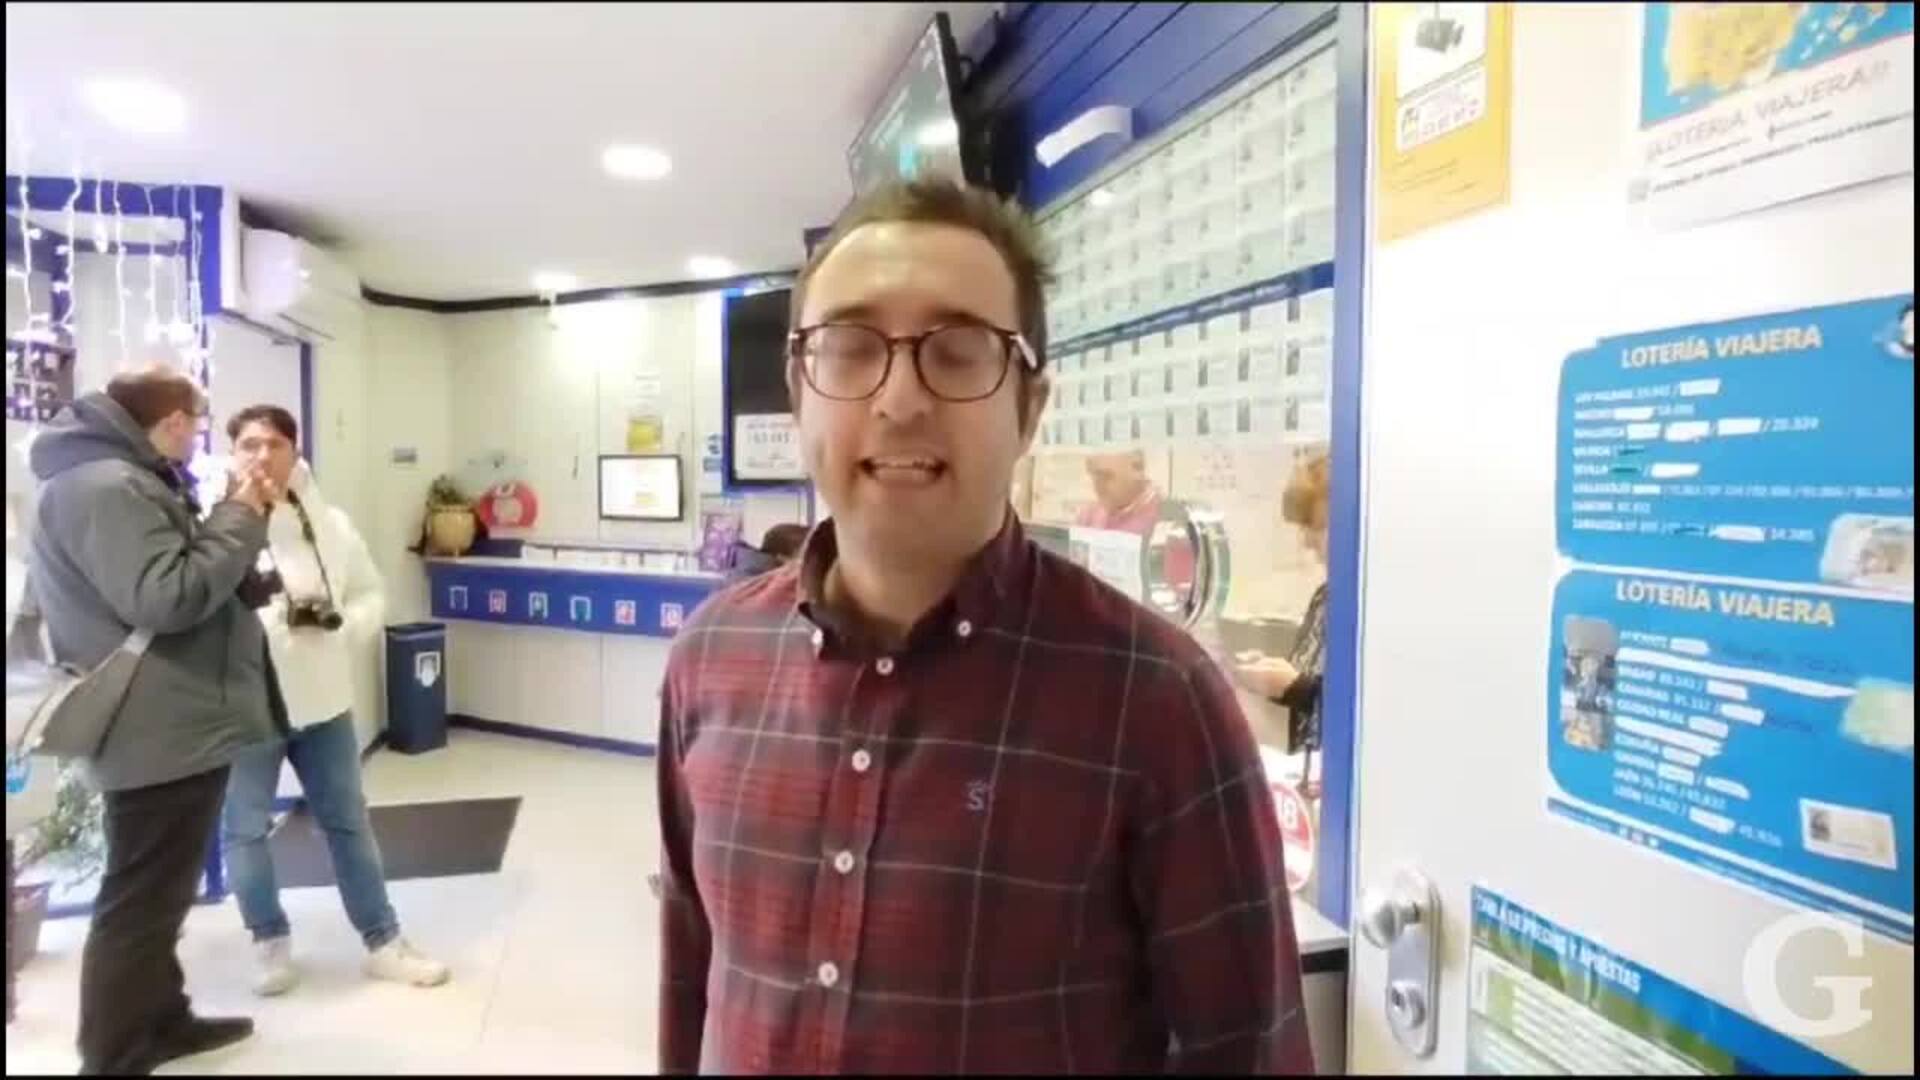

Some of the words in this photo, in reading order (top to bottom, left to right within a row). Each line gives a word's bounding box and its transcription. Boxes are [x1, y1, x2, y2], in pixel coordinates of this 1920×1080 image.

[1621, 334, 1710, 369] LOTERÍA
[1716, 323, 1823, 358] VIAJERA
[1615, 578, 1712, 613] LOTERÍA
[1718, 590, 1836, 628] VIAJERA
